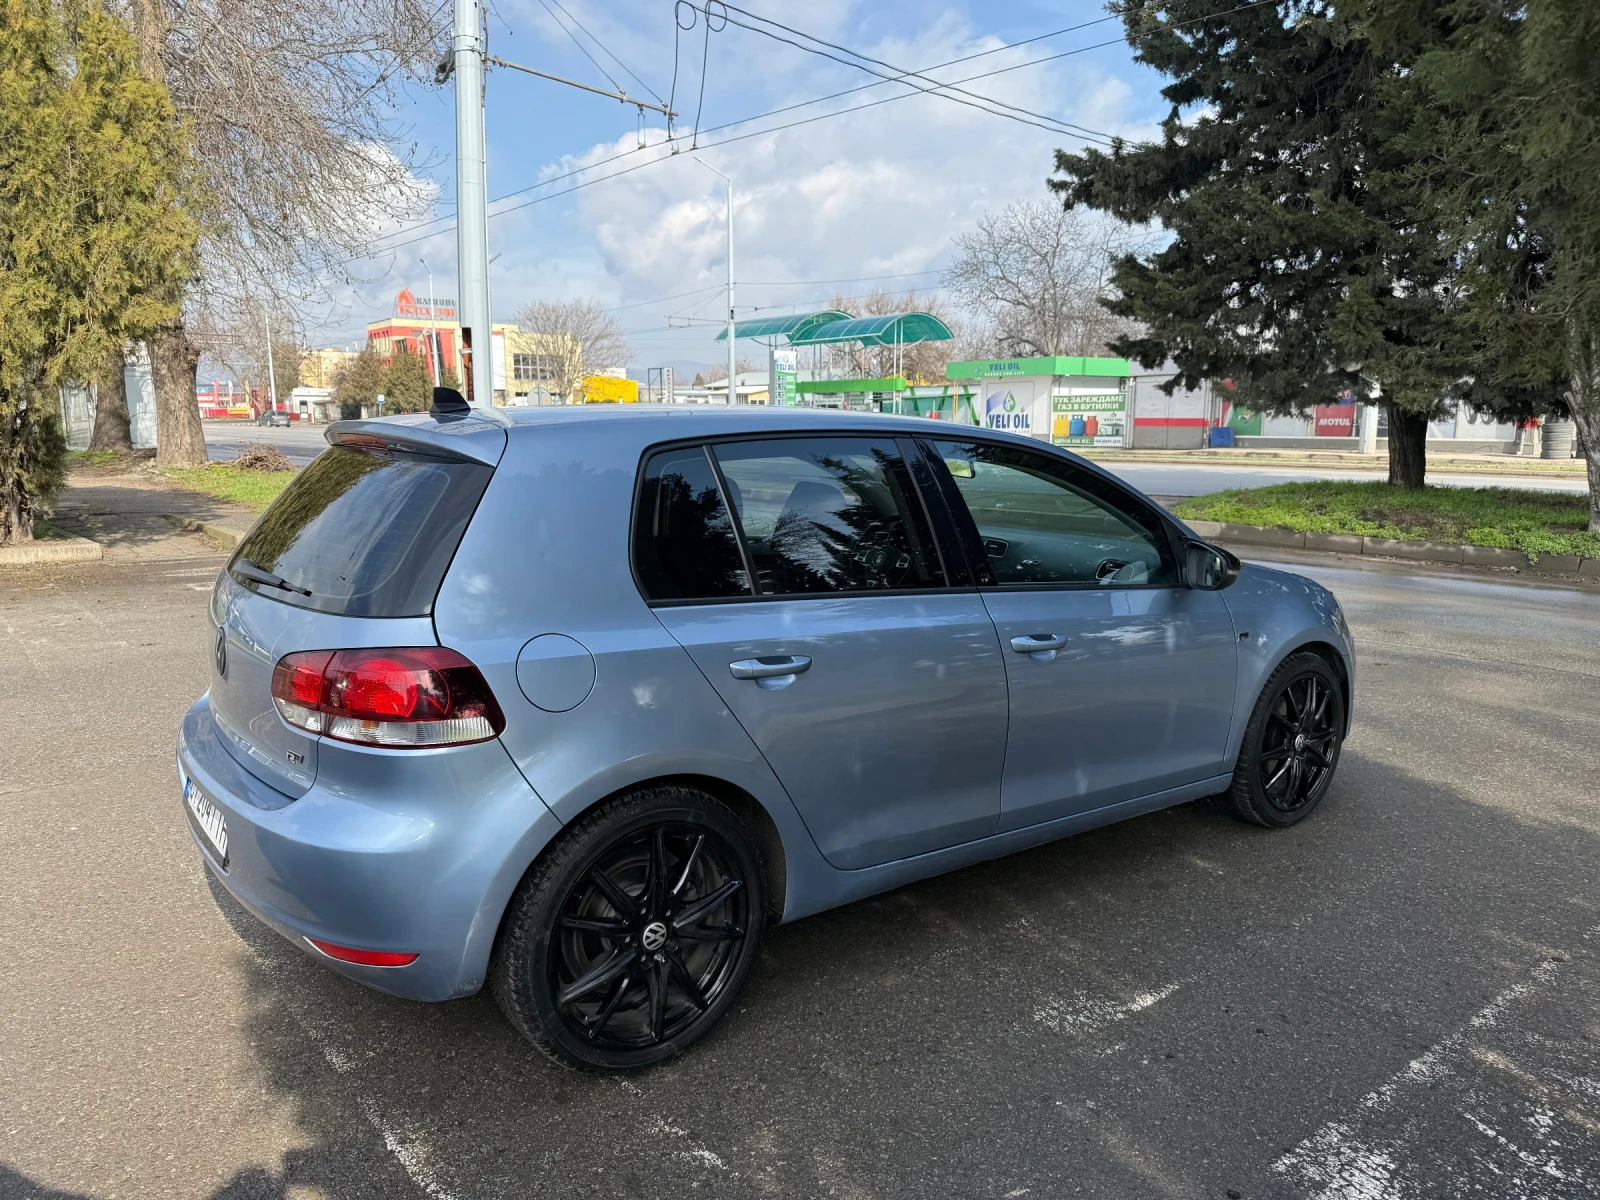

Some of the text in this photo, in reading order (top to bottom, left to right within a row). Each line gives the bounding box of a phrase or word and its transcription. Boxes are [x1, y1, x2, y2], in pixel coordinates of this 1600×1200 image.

[1007, 362, 1020, 370] OIL
[1070, 395, 1124, 403] ЗАРЕЖДАМЕ
[1080, 402, 1119, 410] БУТИЛКИ
[989, 413, 1030, 429] VELI OIL
[1319, 418, 1350, 426] MOTUL
